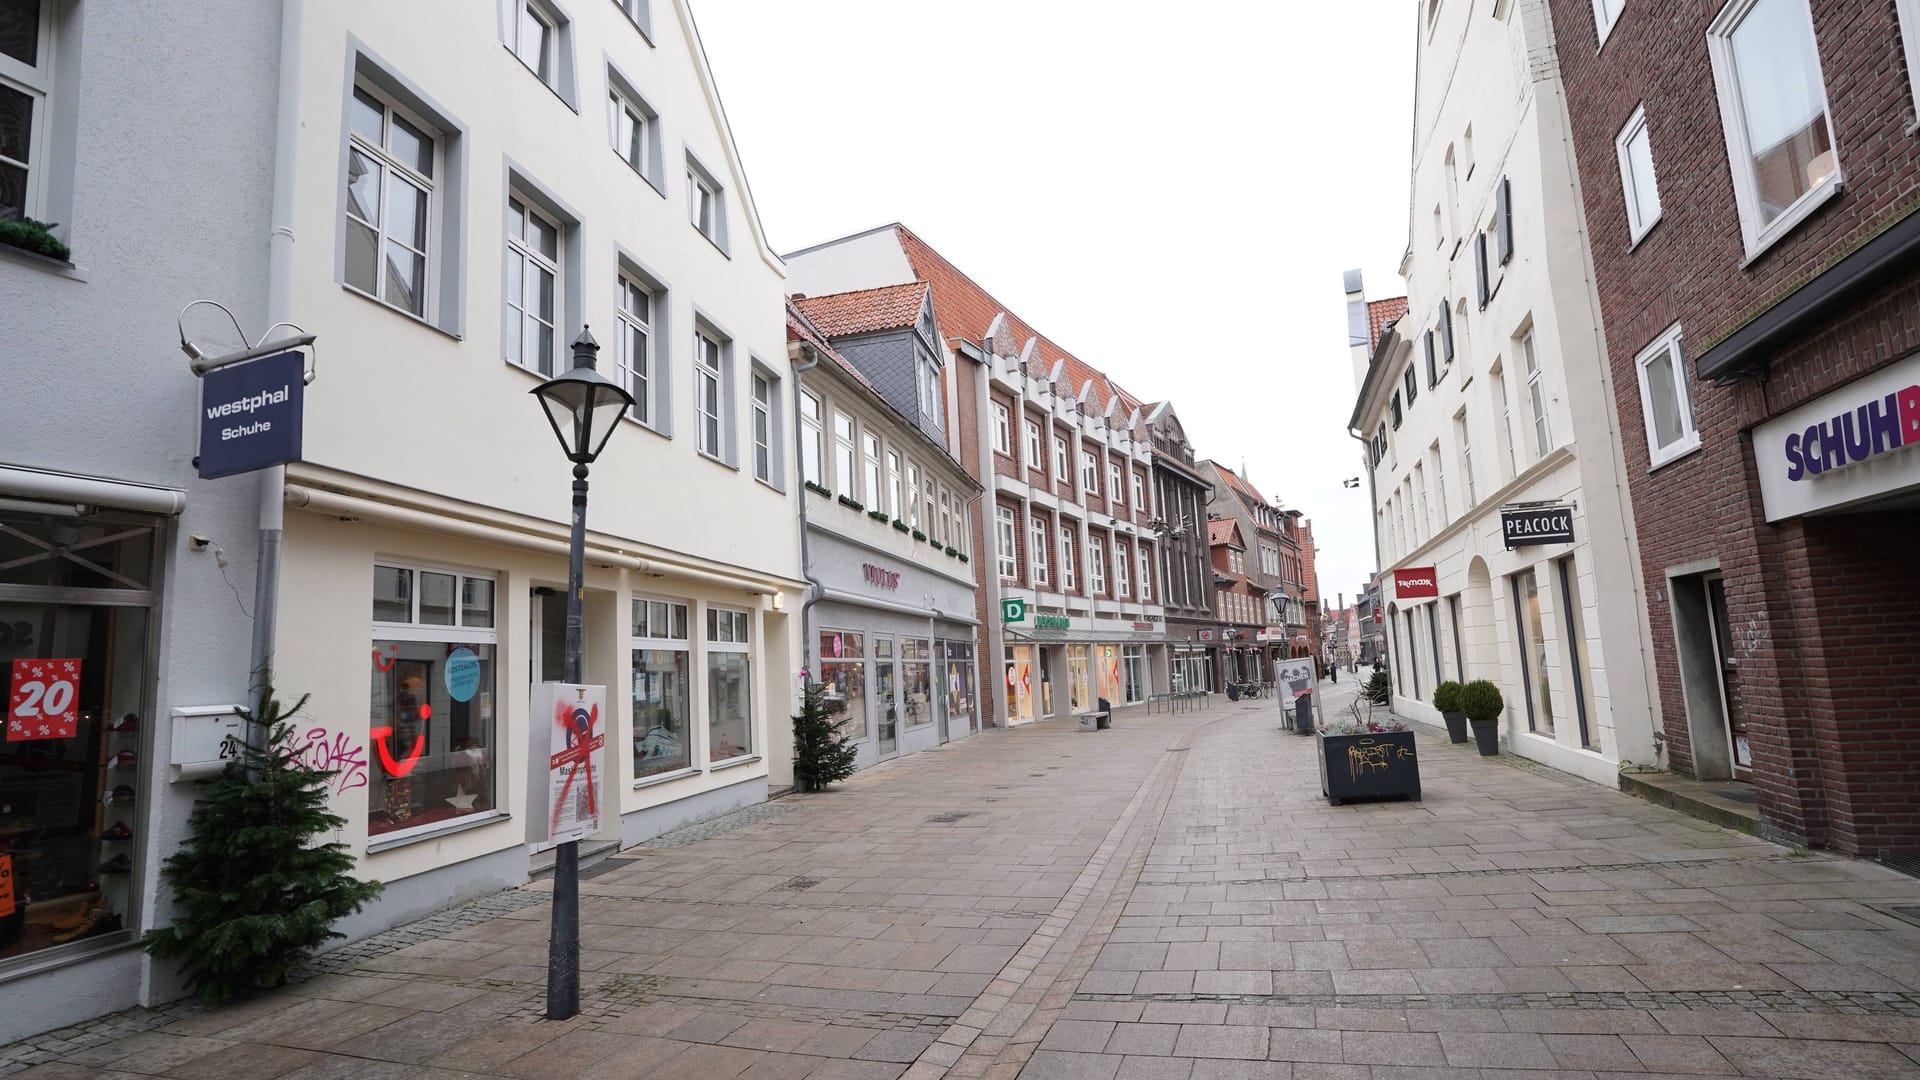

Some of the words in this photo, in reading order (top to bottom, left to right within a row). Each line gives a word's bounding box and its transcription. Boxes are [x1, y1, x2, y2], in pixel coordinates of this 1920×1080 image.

[207, 385, 288, 419] westphal
[221, 421, 271, 440] Schuhe
[1506, 516, 1569, 535] PEACOCK
[1007, 604, 1022, 619] D
[14, 680, 74, 717] 20
[219, 740, 238, 759] 24
